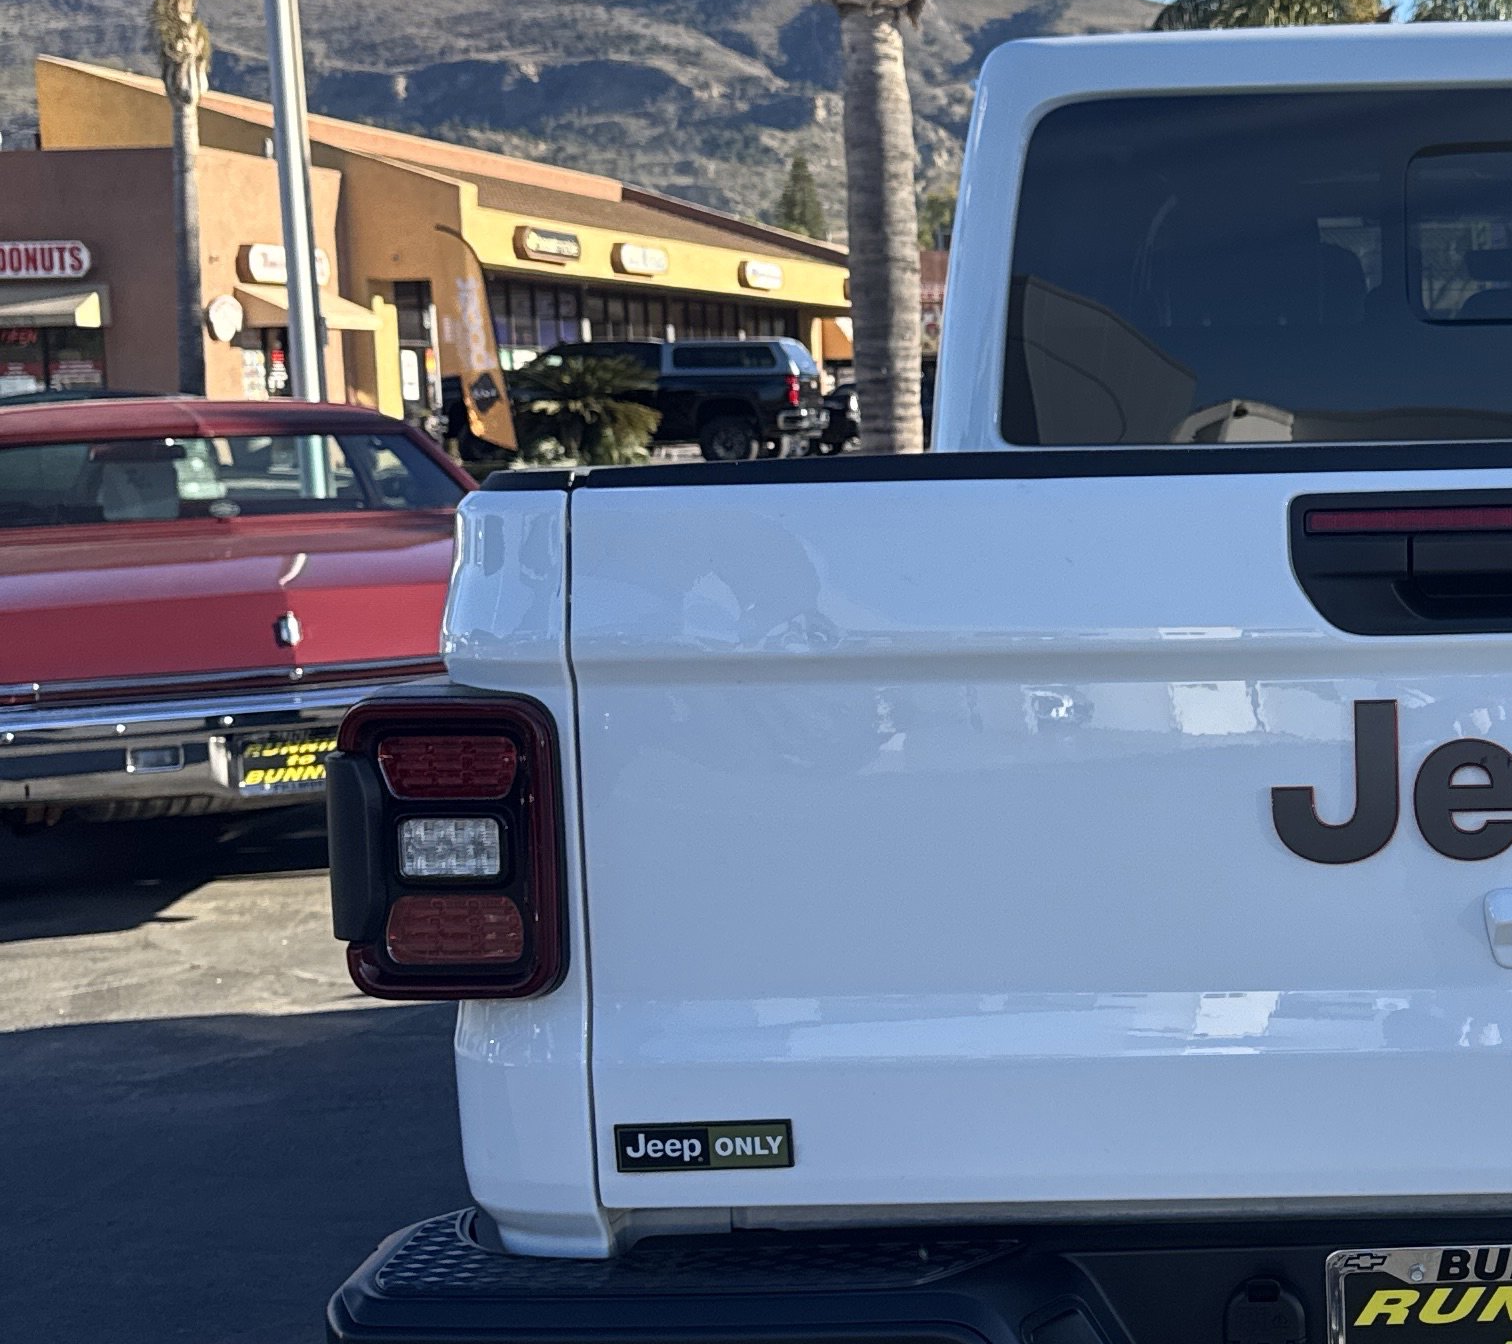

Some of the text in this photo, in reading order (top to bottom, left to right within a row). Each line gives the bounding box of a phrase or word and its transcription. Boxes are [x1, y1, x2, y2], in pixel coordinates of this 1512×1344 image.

[286, 754, 317, 767] to
[626, 1133, 783, 1162] Jeep ONLY
